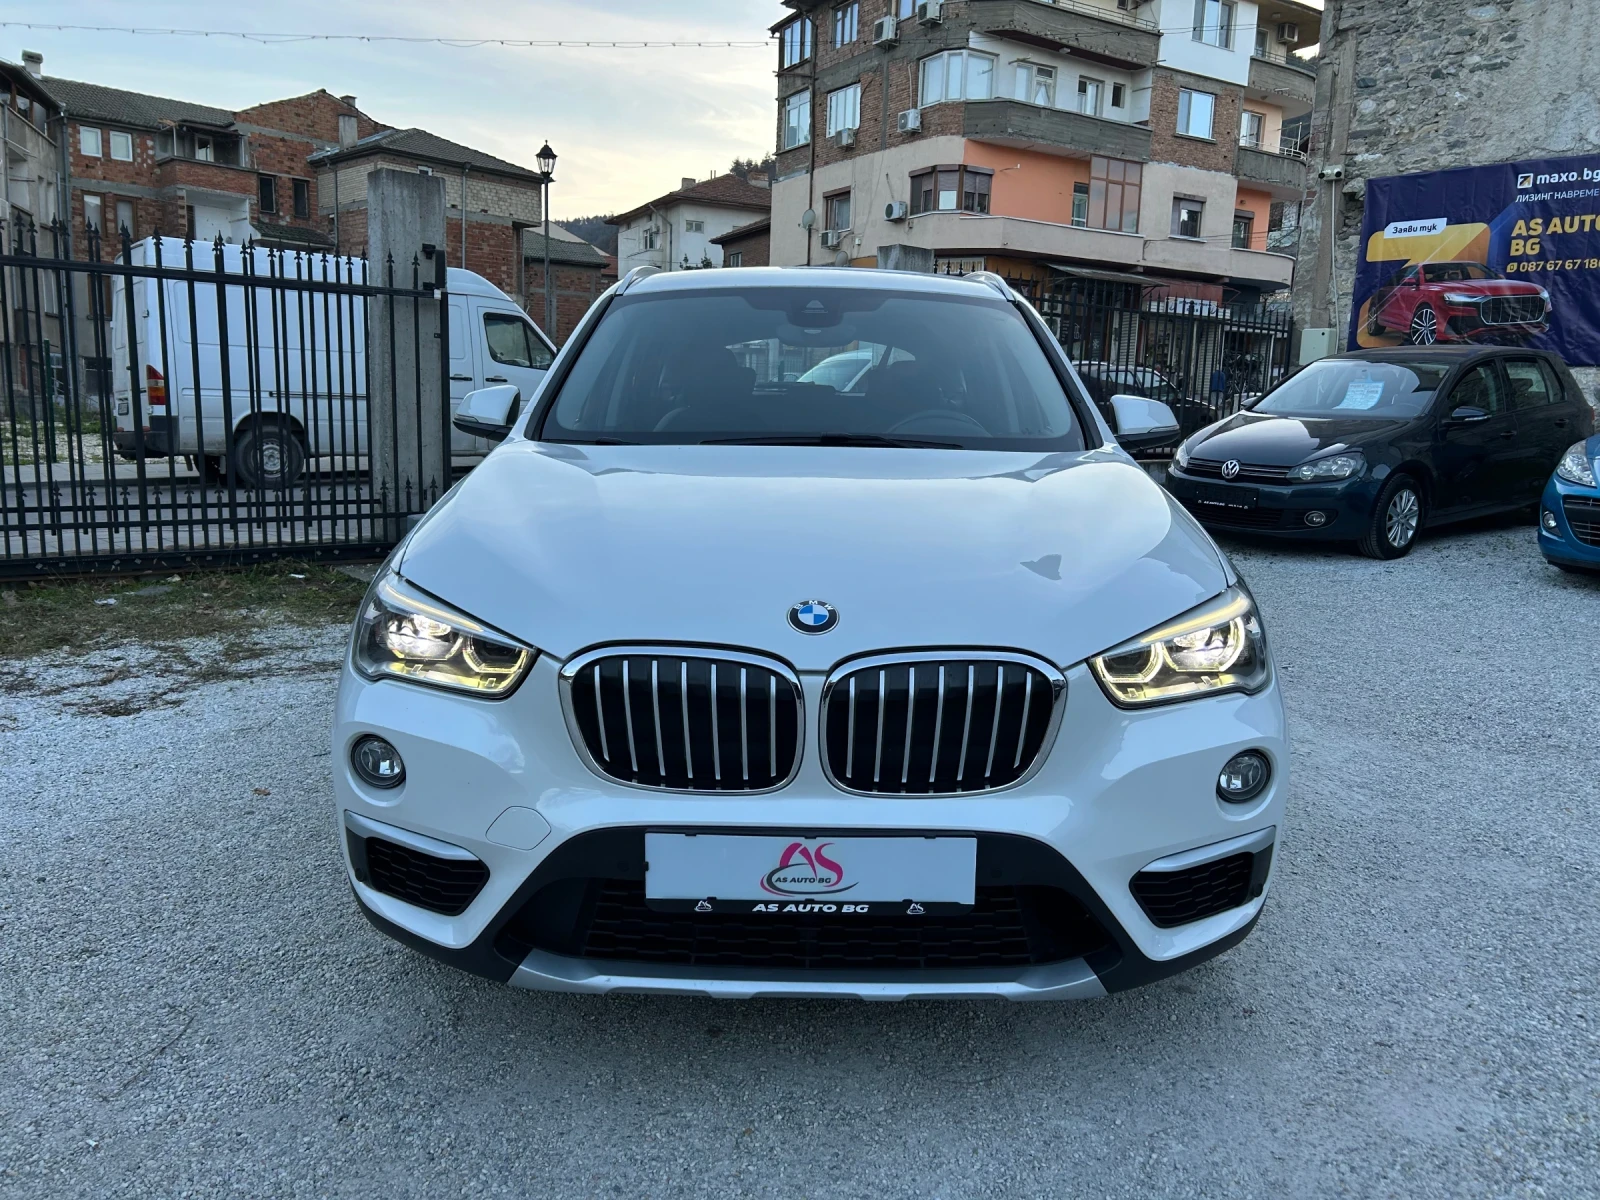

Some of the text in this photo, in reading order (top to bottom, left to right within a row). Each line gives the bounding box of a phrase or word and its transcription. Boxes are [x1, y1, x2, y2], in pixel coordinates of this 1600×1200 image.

[1515, 192, 1553, 202] ЛИЗИНГ
[1511, 218, 1543, 236] AS
[1510, 238, 1540, 256] BG
[1520, 258, 1600, 272] 087 67 67 18
[794, 600, 833, 610] BMW
[752, 904, 869, 913] AS AUTO BG
